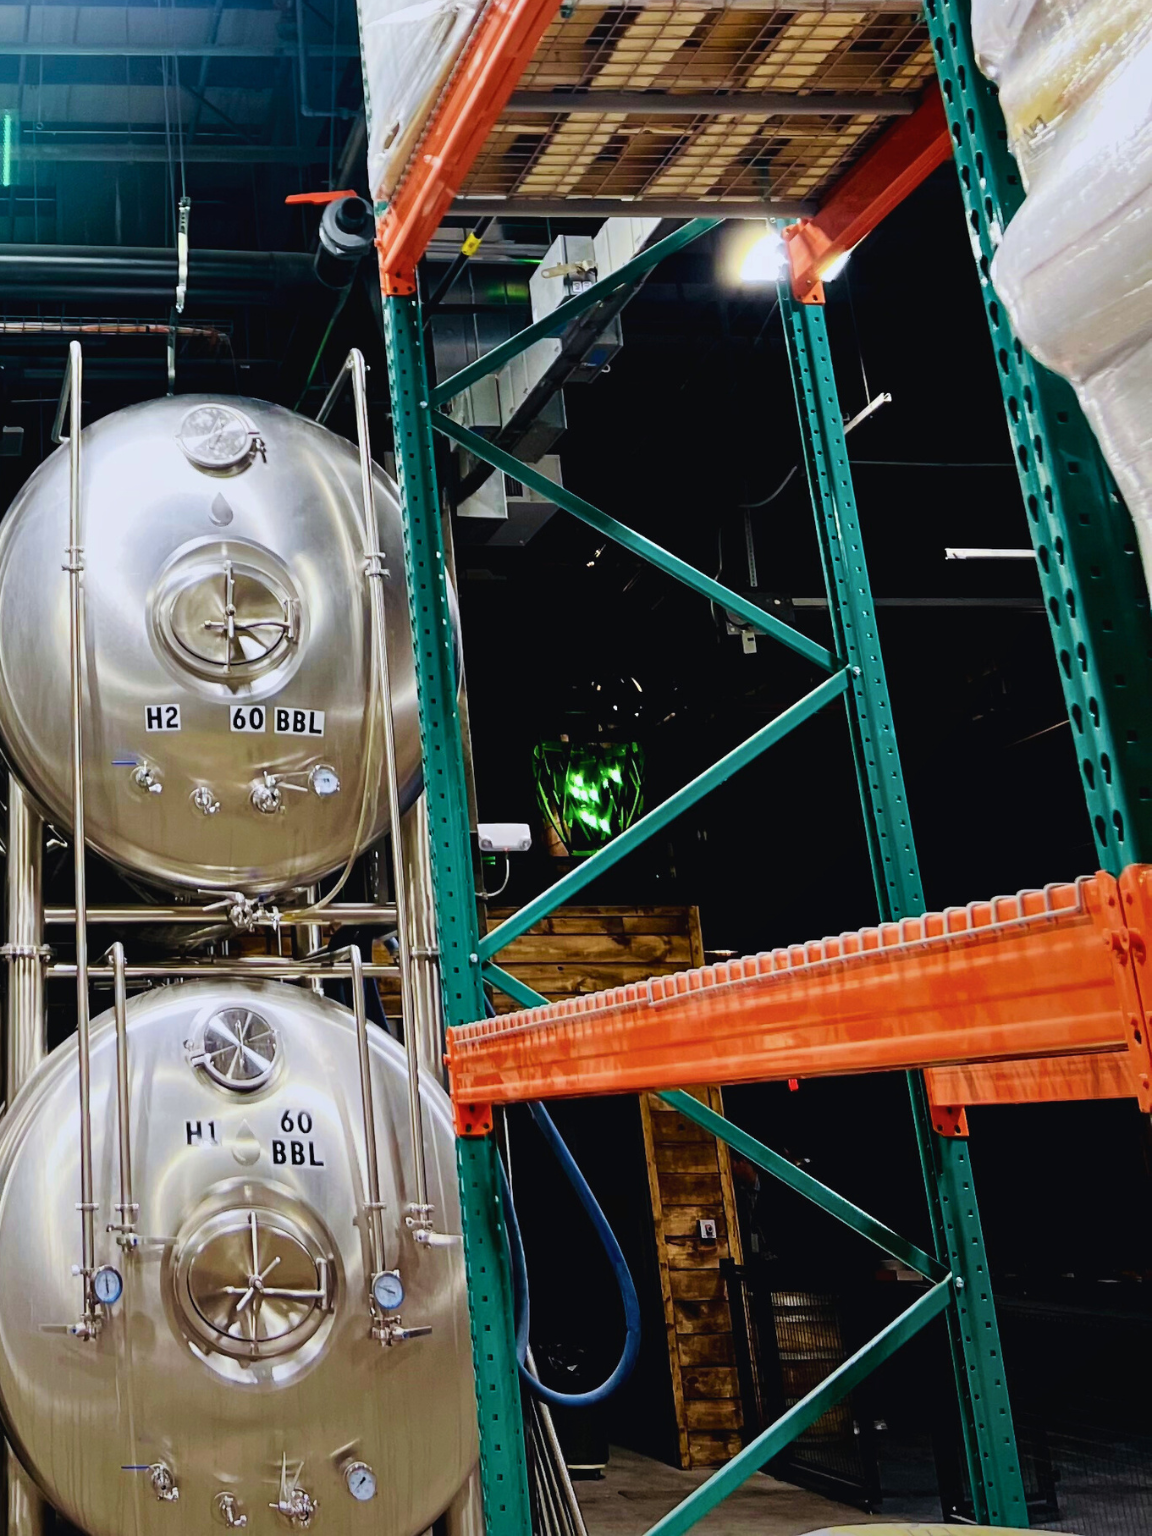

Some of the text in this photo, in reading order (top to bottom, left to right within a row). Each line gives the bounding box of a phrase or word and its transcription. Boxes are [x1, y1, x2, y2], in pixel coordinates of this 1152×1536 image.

[147, 706, 322, 735] H2 60 BBL
[186, 1121, 218, 1145] H1
[281, 1109, 312, 1133] 60
[272, 1139, 324, 1166] BBL
